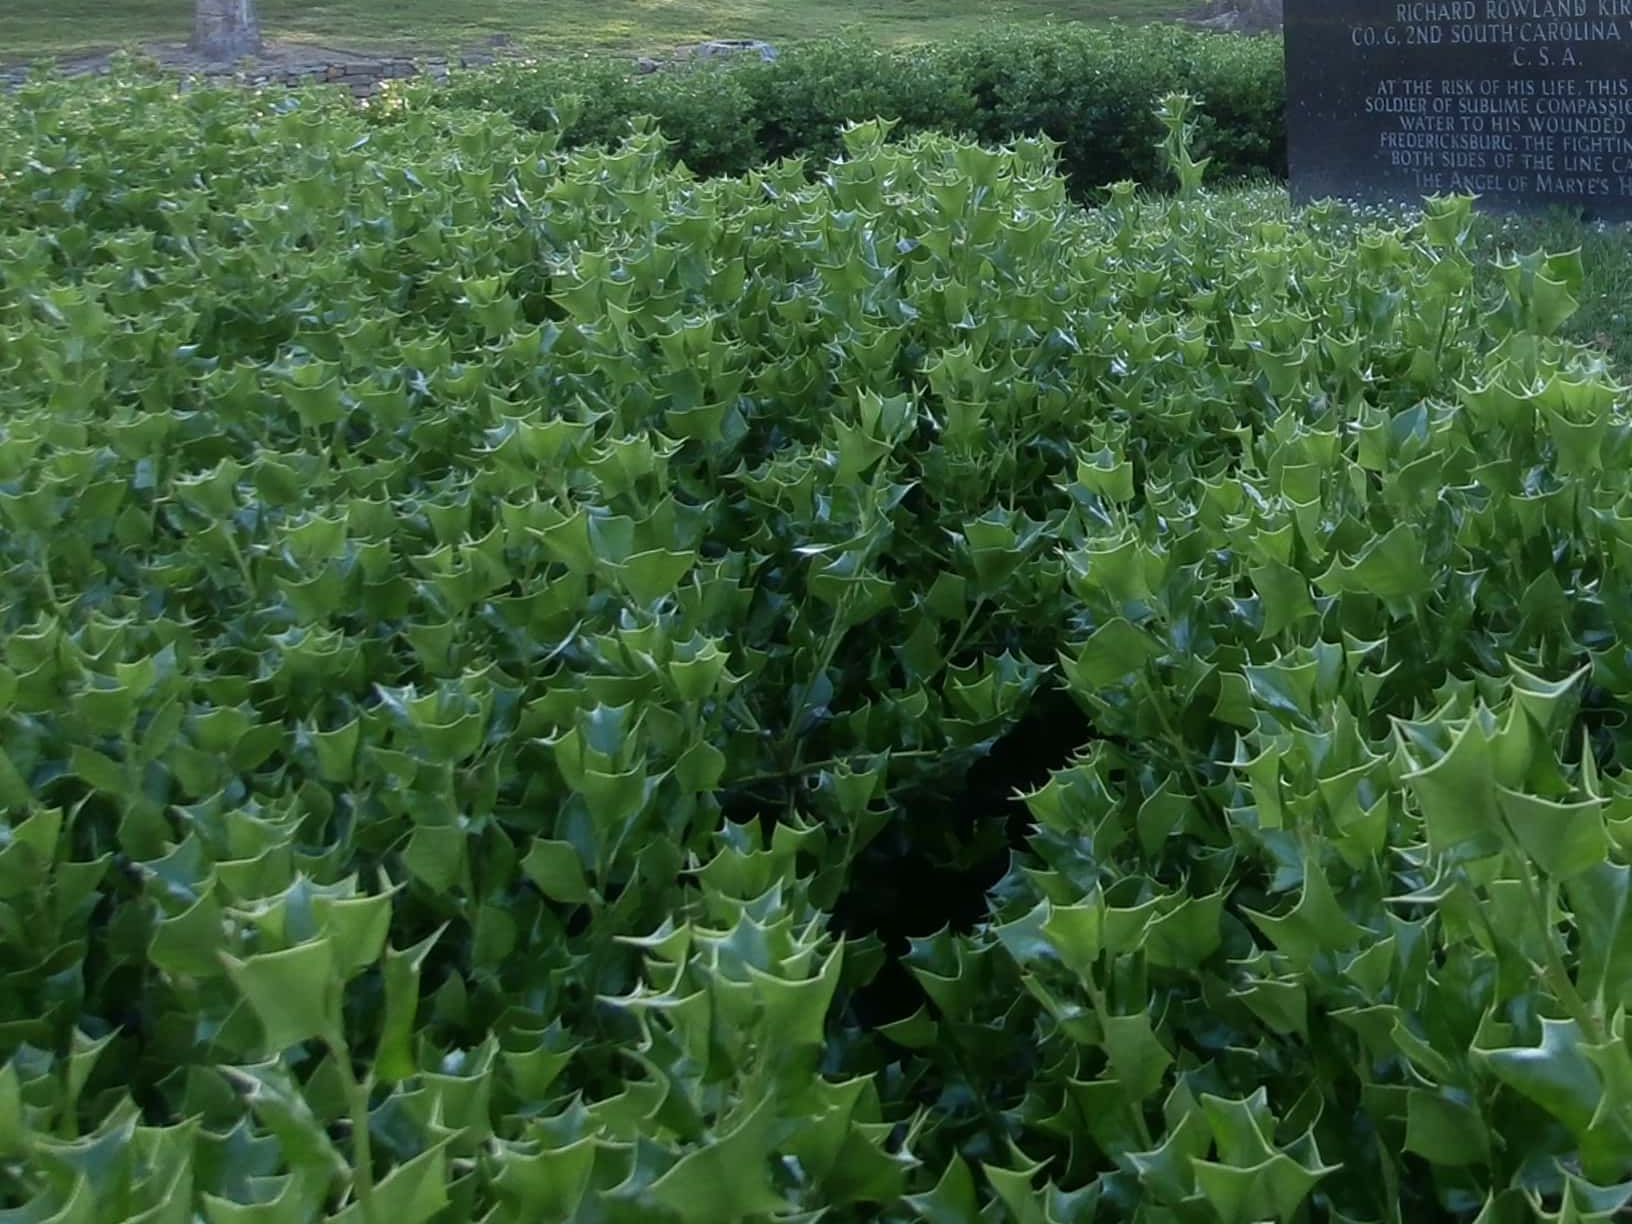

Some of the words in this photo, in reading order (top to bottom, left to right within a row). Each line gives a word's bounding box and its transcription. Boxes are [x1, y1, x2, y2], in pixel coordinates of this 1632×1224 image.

[1396, 1, 1475, 22] RICHARD
[1352, 26, 1380, 46] CO.
[1406, 25, 1441, 44] 2ND
[1450, 24, 1513, 43] SOUTH
[1519, 21, 1621, 42] CAROLINA
[1513, 46, 1532, 67] C.
[1539, 46, 1556, 67] S.
[1562, 47, 1583, 67] A.
[1377, 80, 1395, 95] AT
[1404, 80, 1432, 95] THE
[1442, 80, 1473, 95] RISK
[1480, 80, 1499, 95] OF
[1507, 80, 1535, 95] HIS
[1585, 79, 1628, 96] THIS
[1365, 97, 1426, 113] SOLDIER
[1433, 98, 1452, 113] OF
[1459, 97, 1528, 114] SUBLIME
[1400, 117, 1455, 132] WATER
[1460, 117, 1484, 132] TO
[1491, 117, 1521, 133] HIS
[1528, 117, 1626, 135] WOUNDED
[1522, 135, 1553, 151] THE
[1391, 151, 1434, 166] BOTH
[1442, 151, 1486, 168] SIDES
[1495, 153, 1514, 169] OF
[1521, 154, 1554, 170] THE
[1564, 155, 1603, 172] LINE
